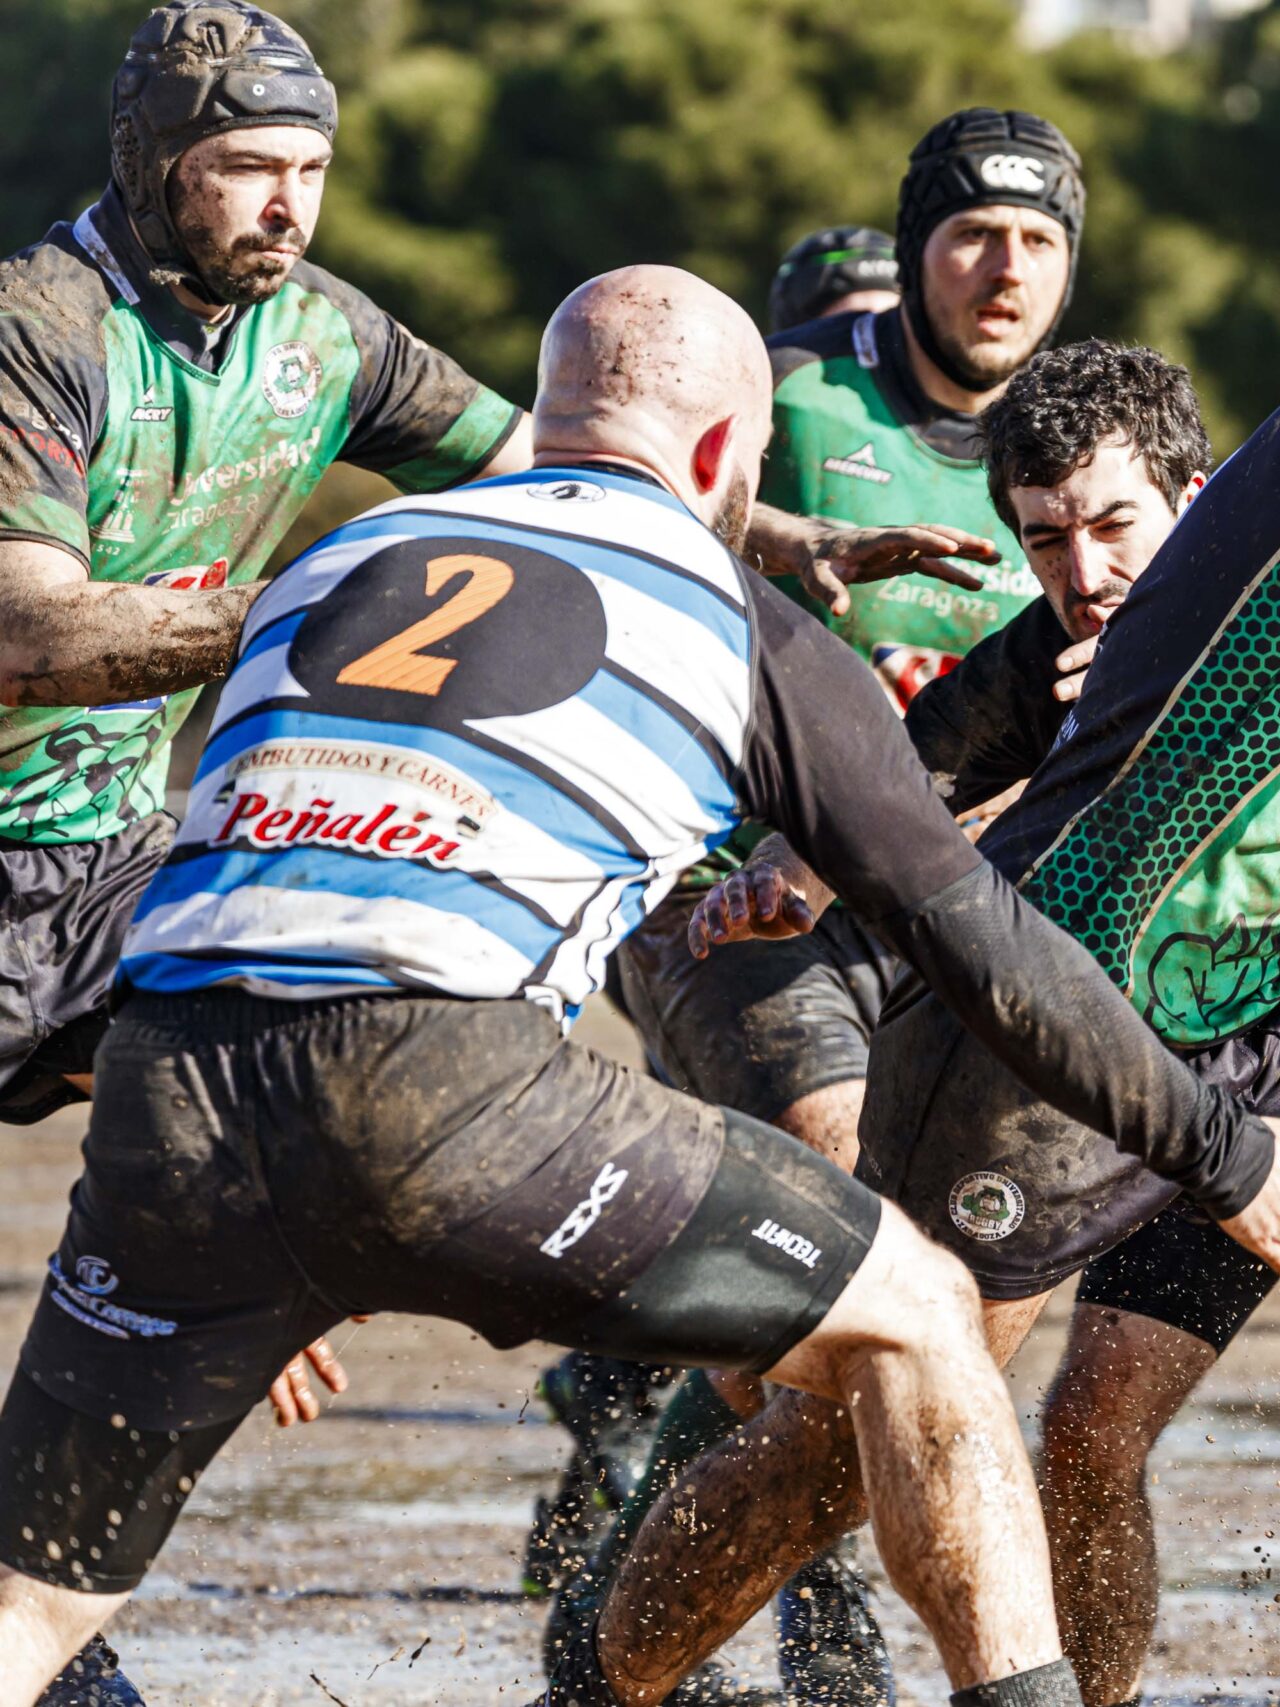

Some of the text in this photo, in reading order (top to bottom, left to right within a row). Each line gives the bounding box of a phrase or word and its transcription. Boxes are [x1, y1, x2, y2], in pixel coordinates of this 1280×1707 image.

[336, 554, 514, 697] 2
[877, 575, 999, 622] Zaragoza
[379, 751, 398, 771] Y
[399, 755, 489, 817] CARNES
[214, 792, 460, 861] Peñalén
[751, 1218, 822, 1269] TECHFIT
[969, 1214, 1002, 1231] RUGBY
